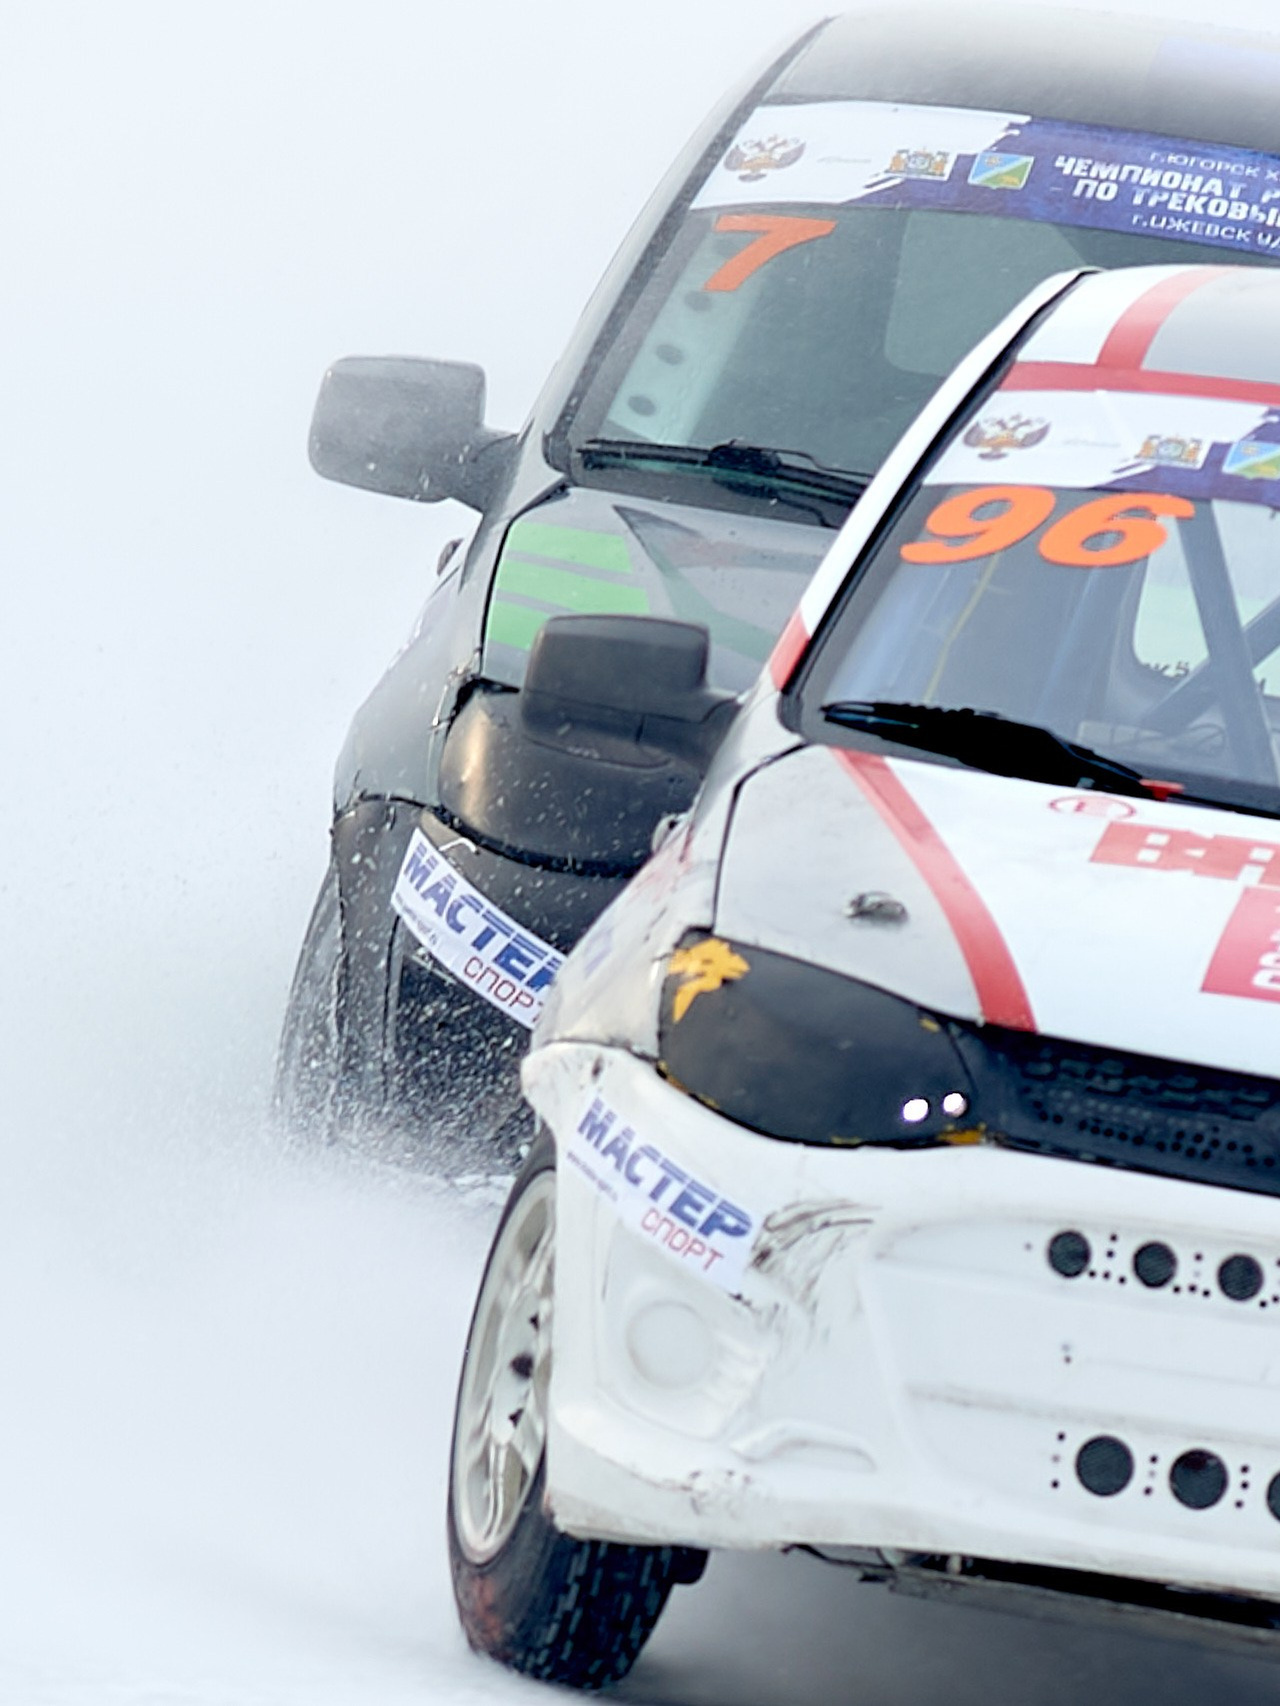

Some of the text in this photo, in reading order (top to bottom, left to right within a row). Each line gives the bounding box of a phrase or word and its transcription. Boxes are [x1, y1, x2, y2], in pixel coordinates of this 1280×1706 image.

[1054, 155, 1247, 199] ЧЕМПИОНАТ
[1072, 178, 1119, 202] ПО
[703, 214, 837, 293] 7
[900, 485, 1196, 568] 96
[577, 1097, 753, 1237] МАСТЕР
[640, 1207, 724, 1271] СПОРТ
